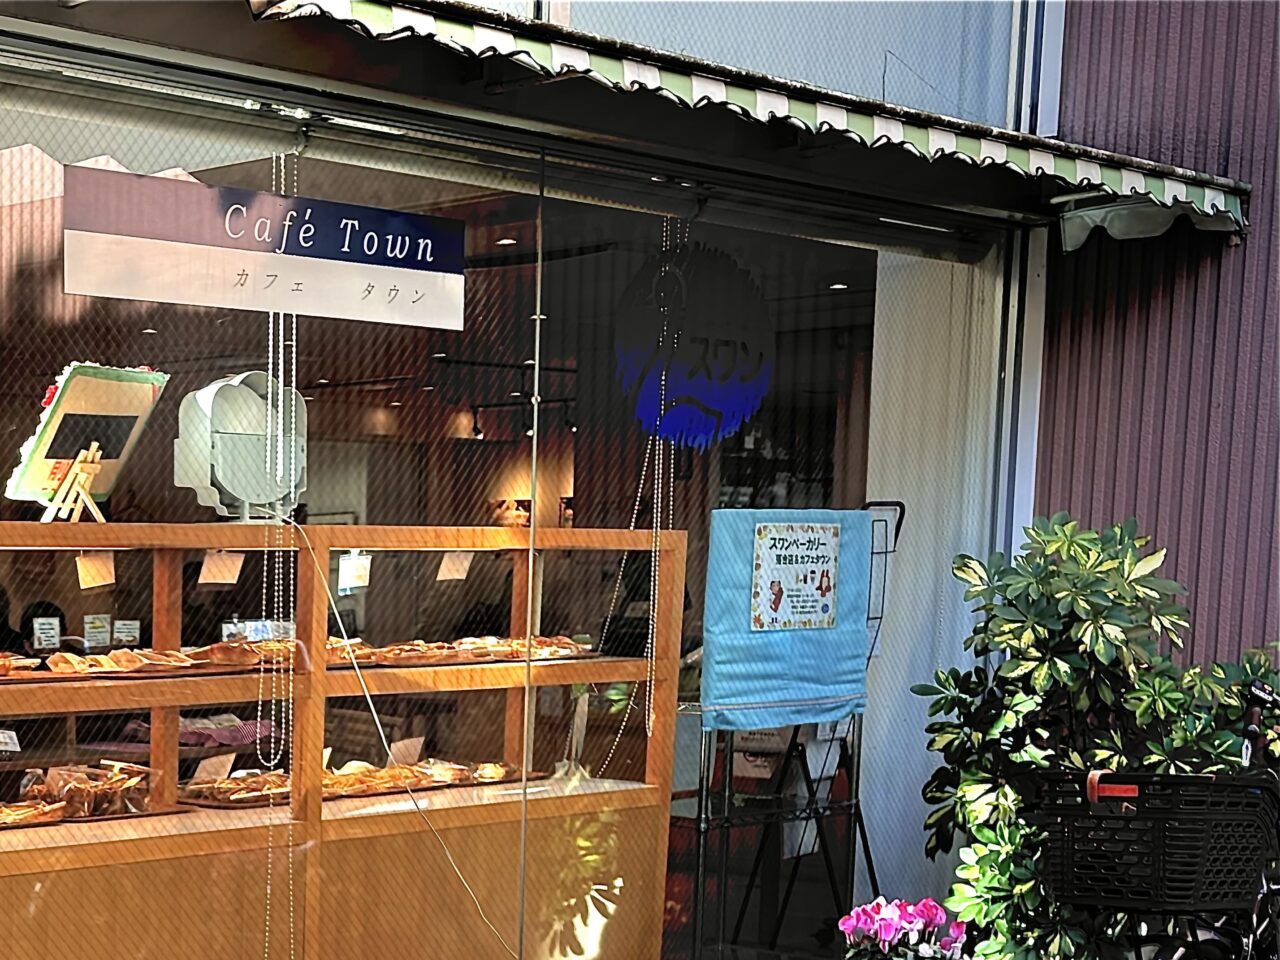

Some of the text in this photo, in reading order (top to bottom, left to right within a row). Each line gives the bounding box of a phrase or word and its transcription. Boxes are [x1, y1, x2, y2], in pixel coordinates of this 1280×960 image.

[224, 204, 434, 262] Café Town
[233, 268, 427, 305] カフェ タウン
[687, 336, 764, 384] スワン
[768, 536, 827, 551] スワンベーカリー
